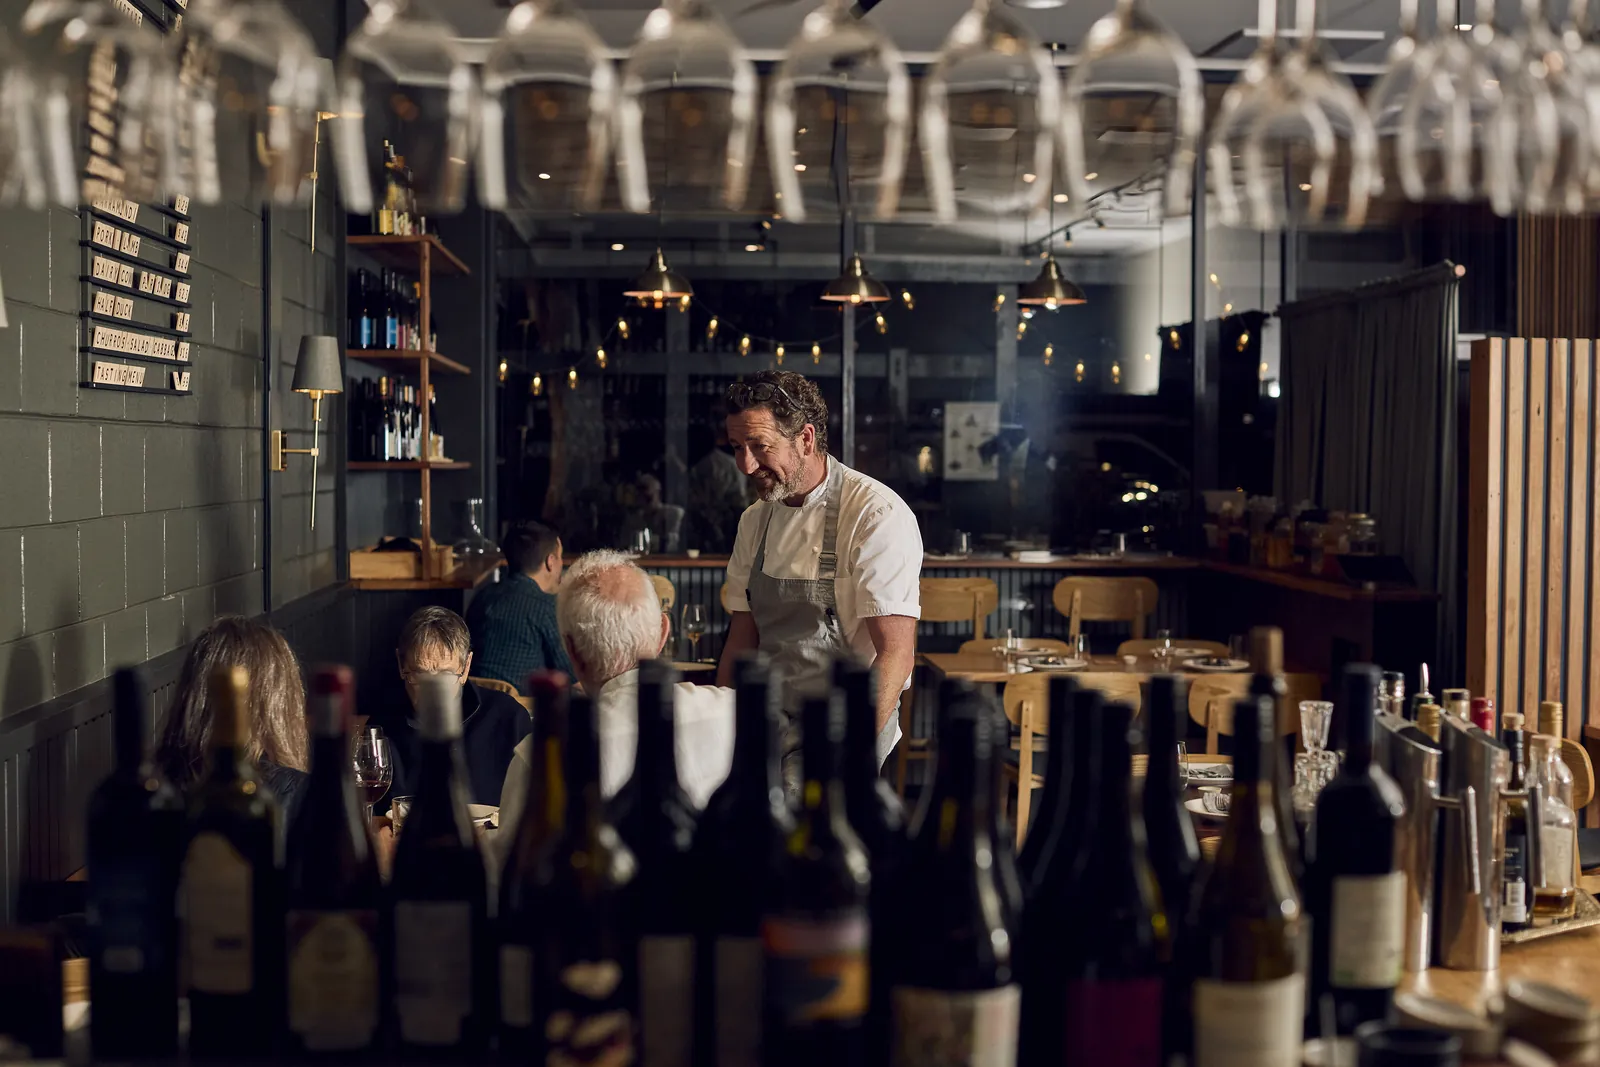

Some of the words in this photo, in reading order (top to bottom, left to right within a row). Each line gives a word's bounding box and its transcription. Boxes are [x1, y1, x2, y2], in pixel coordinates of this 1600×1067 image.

[96, 226, 113, 246] PORK
[96, 262, 118, 281] DAIRY
[97, 296, 113, 313] HALF
[117, 301, 132, 317] DUCK
[96, 331, 126, 350] CHURROS
[130, 337, 149, 354] SALAD
[153, 341, 175, 357] CABBAG
[97, 366, 126, 382] TASTING
[127, 369, 145, 384] MENU
